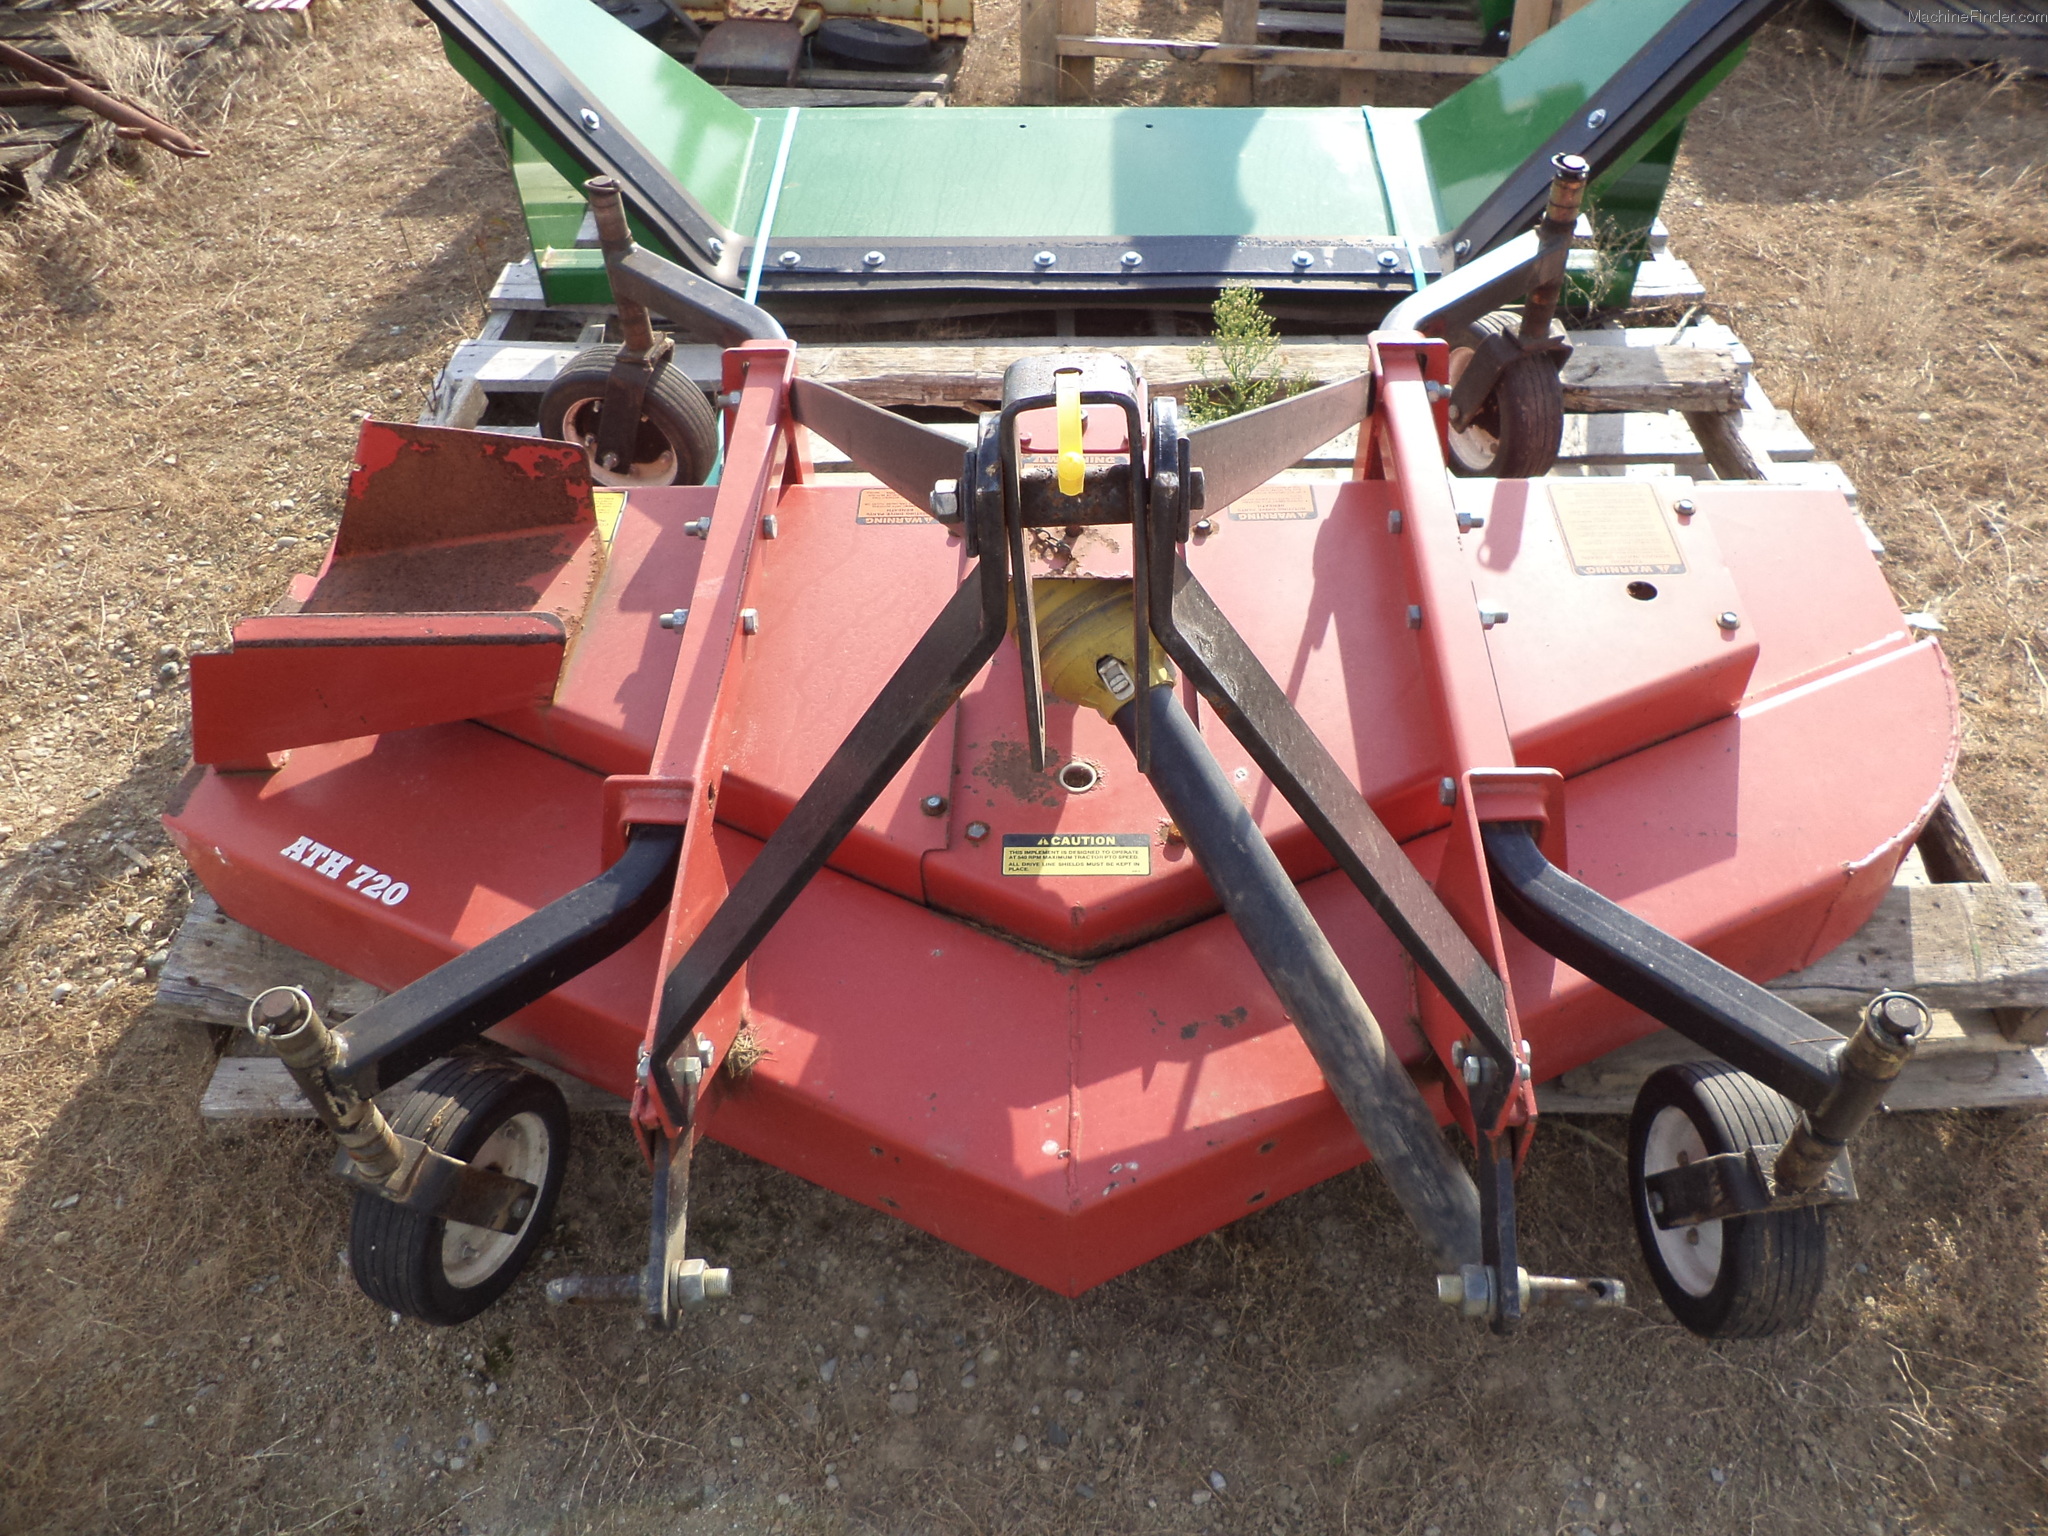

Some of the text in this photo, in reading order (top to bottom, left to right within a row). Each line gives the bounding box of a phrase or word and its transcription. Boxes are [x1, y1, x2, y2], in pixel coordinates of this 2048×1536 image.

[1585, 566, 1653, 574] WARNING
[1051, 836, 1116, 846] CAUTION
[280, 835, 409, 906] ATH 720
